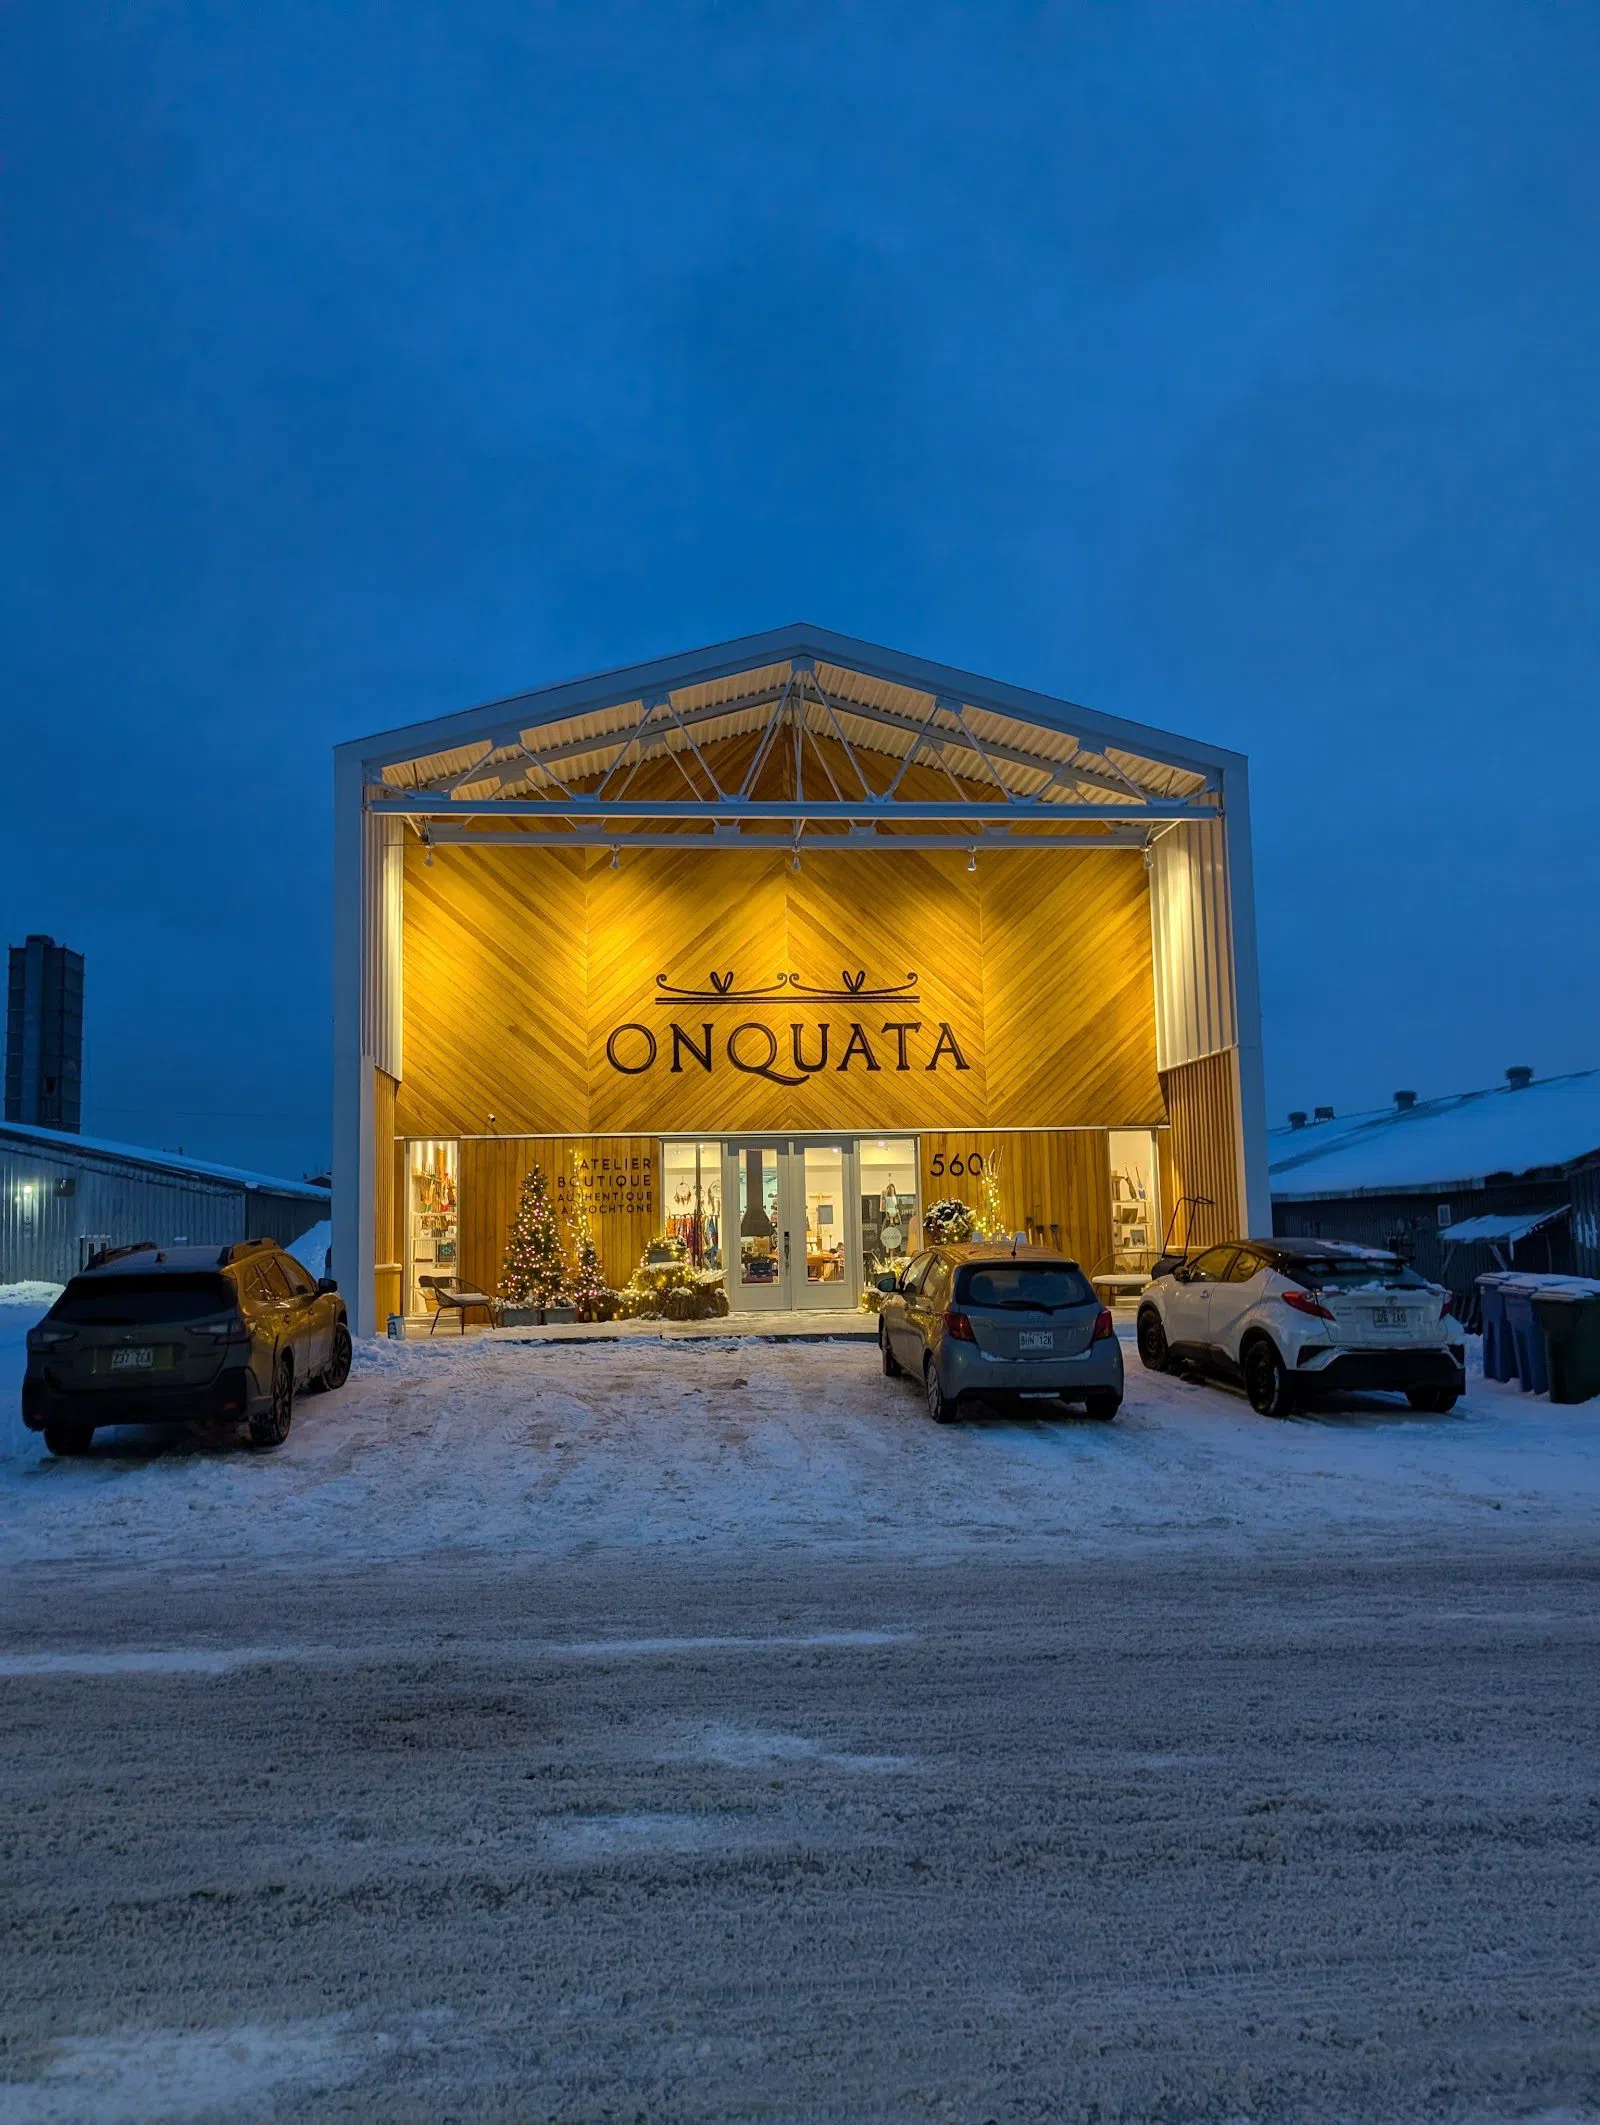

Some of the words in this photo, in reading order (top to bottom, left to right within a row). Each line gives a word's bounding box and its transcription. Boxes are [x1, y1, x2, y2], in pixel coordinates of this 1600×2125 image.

[606, 1022, 970, 1086] ONQUATA
[580, 1158, 651, 1170] ATELIER
[930, 1153, 983, 1176] 560
[557, 1175, 651, 1188] BOUTIQUE
[557, 1191, 652, 1203] AUHENTIQUE
[561, 1203, 653, 1215] AOCHTONE
